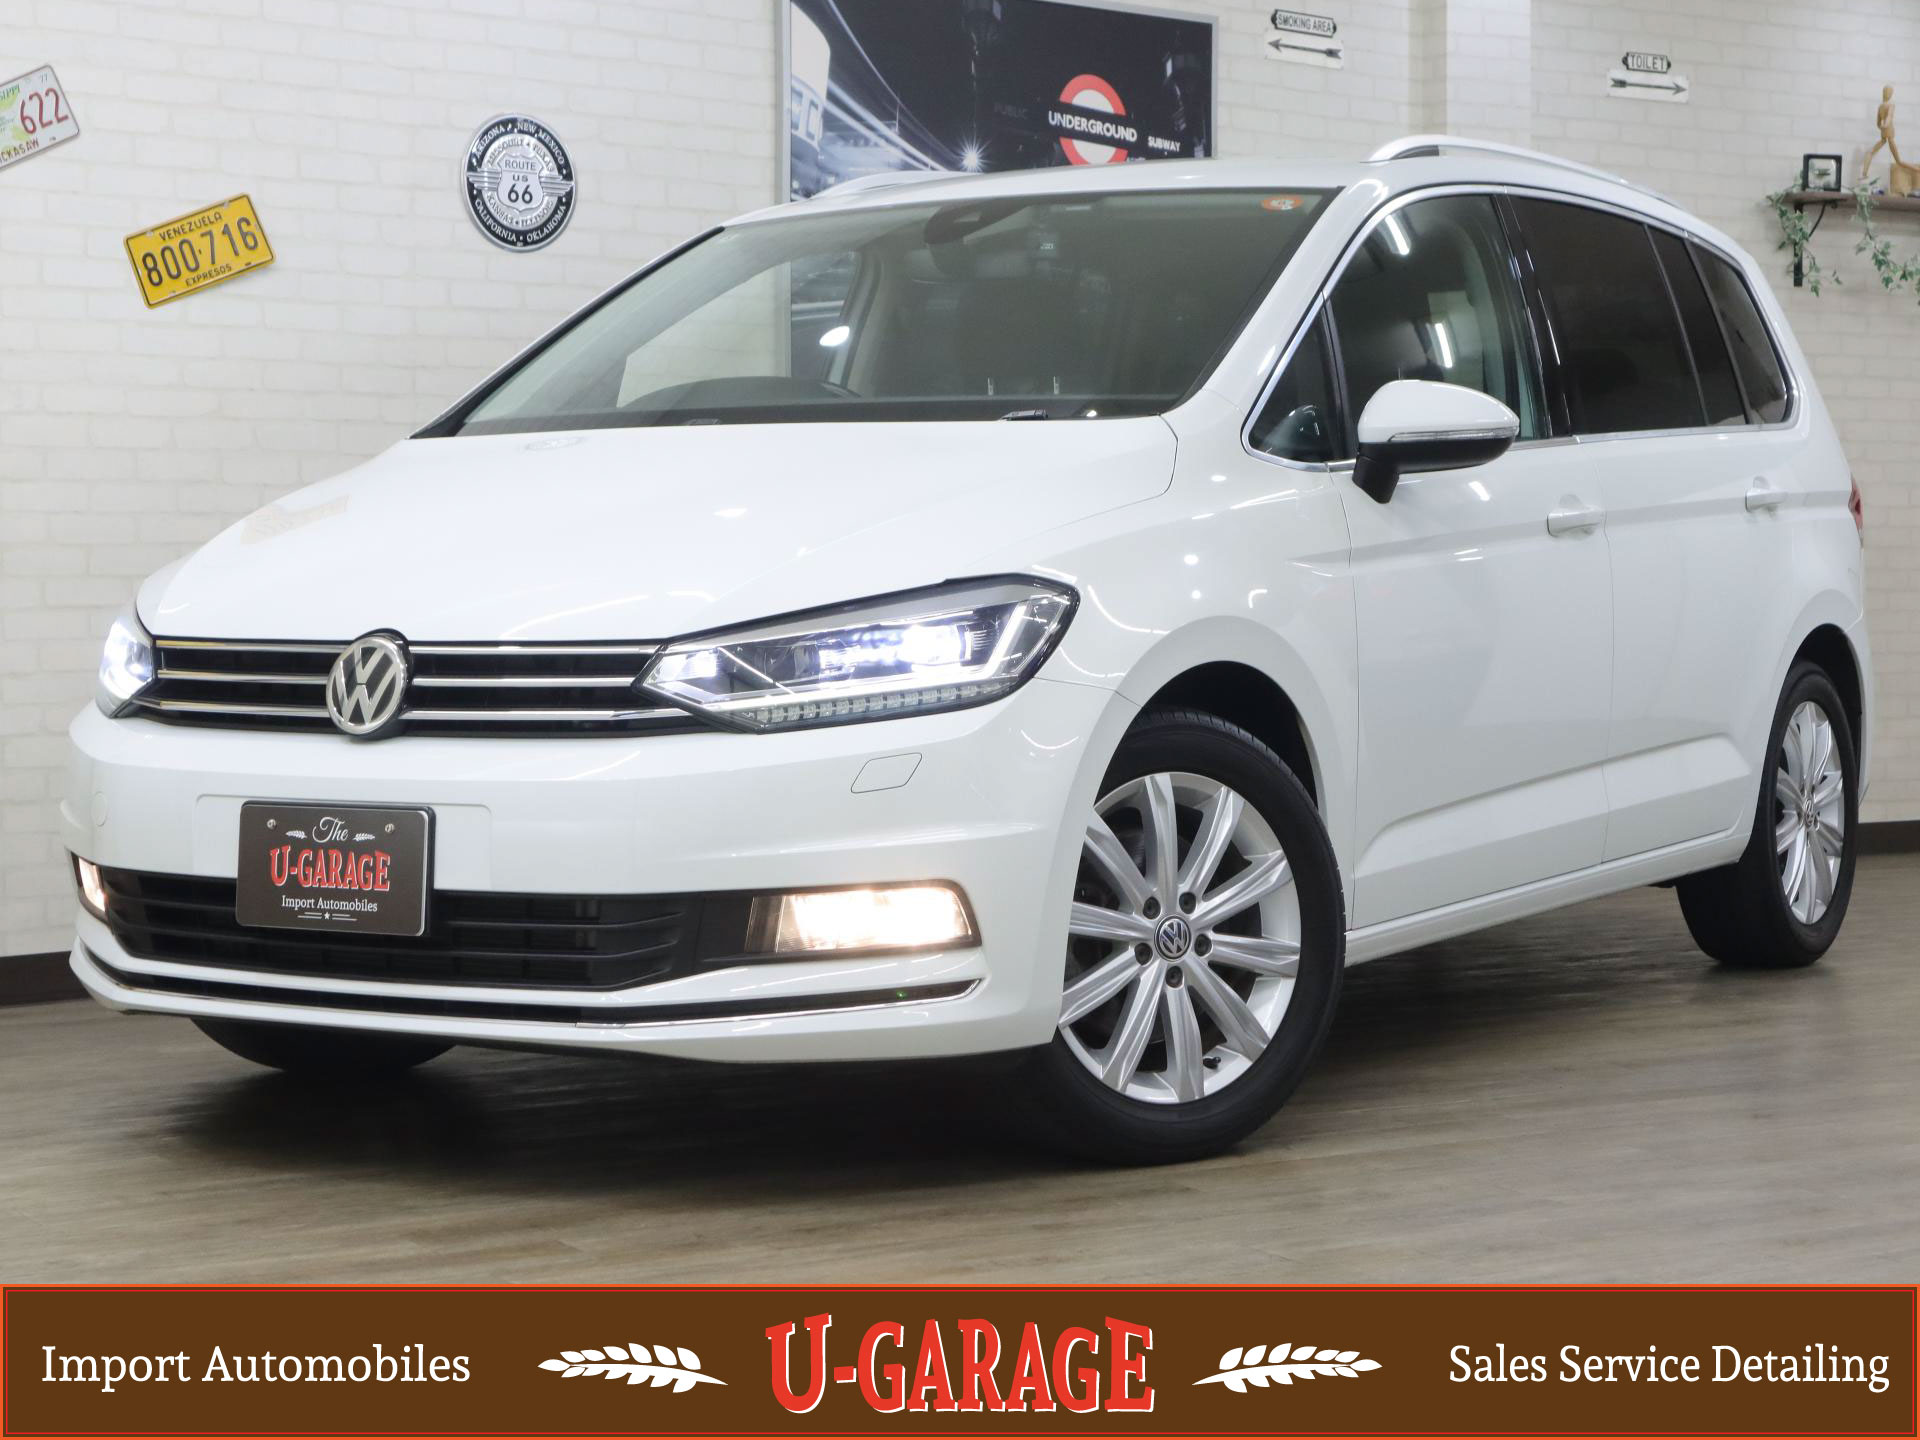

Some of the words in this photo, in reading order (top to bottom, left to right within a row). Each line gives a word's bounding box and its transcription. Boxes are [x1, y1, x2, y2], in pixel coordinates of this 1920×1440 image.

[1277, 14, 1312, 30] SMOKING
[1312, 20, 1332, 33] AREA
[1630, 54, 1666, 70] TOILET
[20, 88, 69, 134] 622
[1048, 110, 1138, 143] UNDERGROUND
[475, 125, 506, 158] ARIZONA
[517, 121, 537, 134] NEW
[538, 128, 565, 166] MEXICO
[1147, 135, 1181, 153] SUBWAY
[504, 159, 537, 171] ROUTE
[486, 193, 514, 225] KANSAS
[508, 183, 533, 205] 66
[159, 211, 223, 242] VENEZUELA
[474, 197, 517, 243] CALIFORNIA
[526, 205, 567, 243] OKLAHOMA
[185, 263, 233, 288] EXPRESOS
[312, 816, 350, 843] The
[270, 844, 392, 892] U-GARAGE
[281, 895, 316, 911] Import
[317, 898, 379, 912] Automobiles
